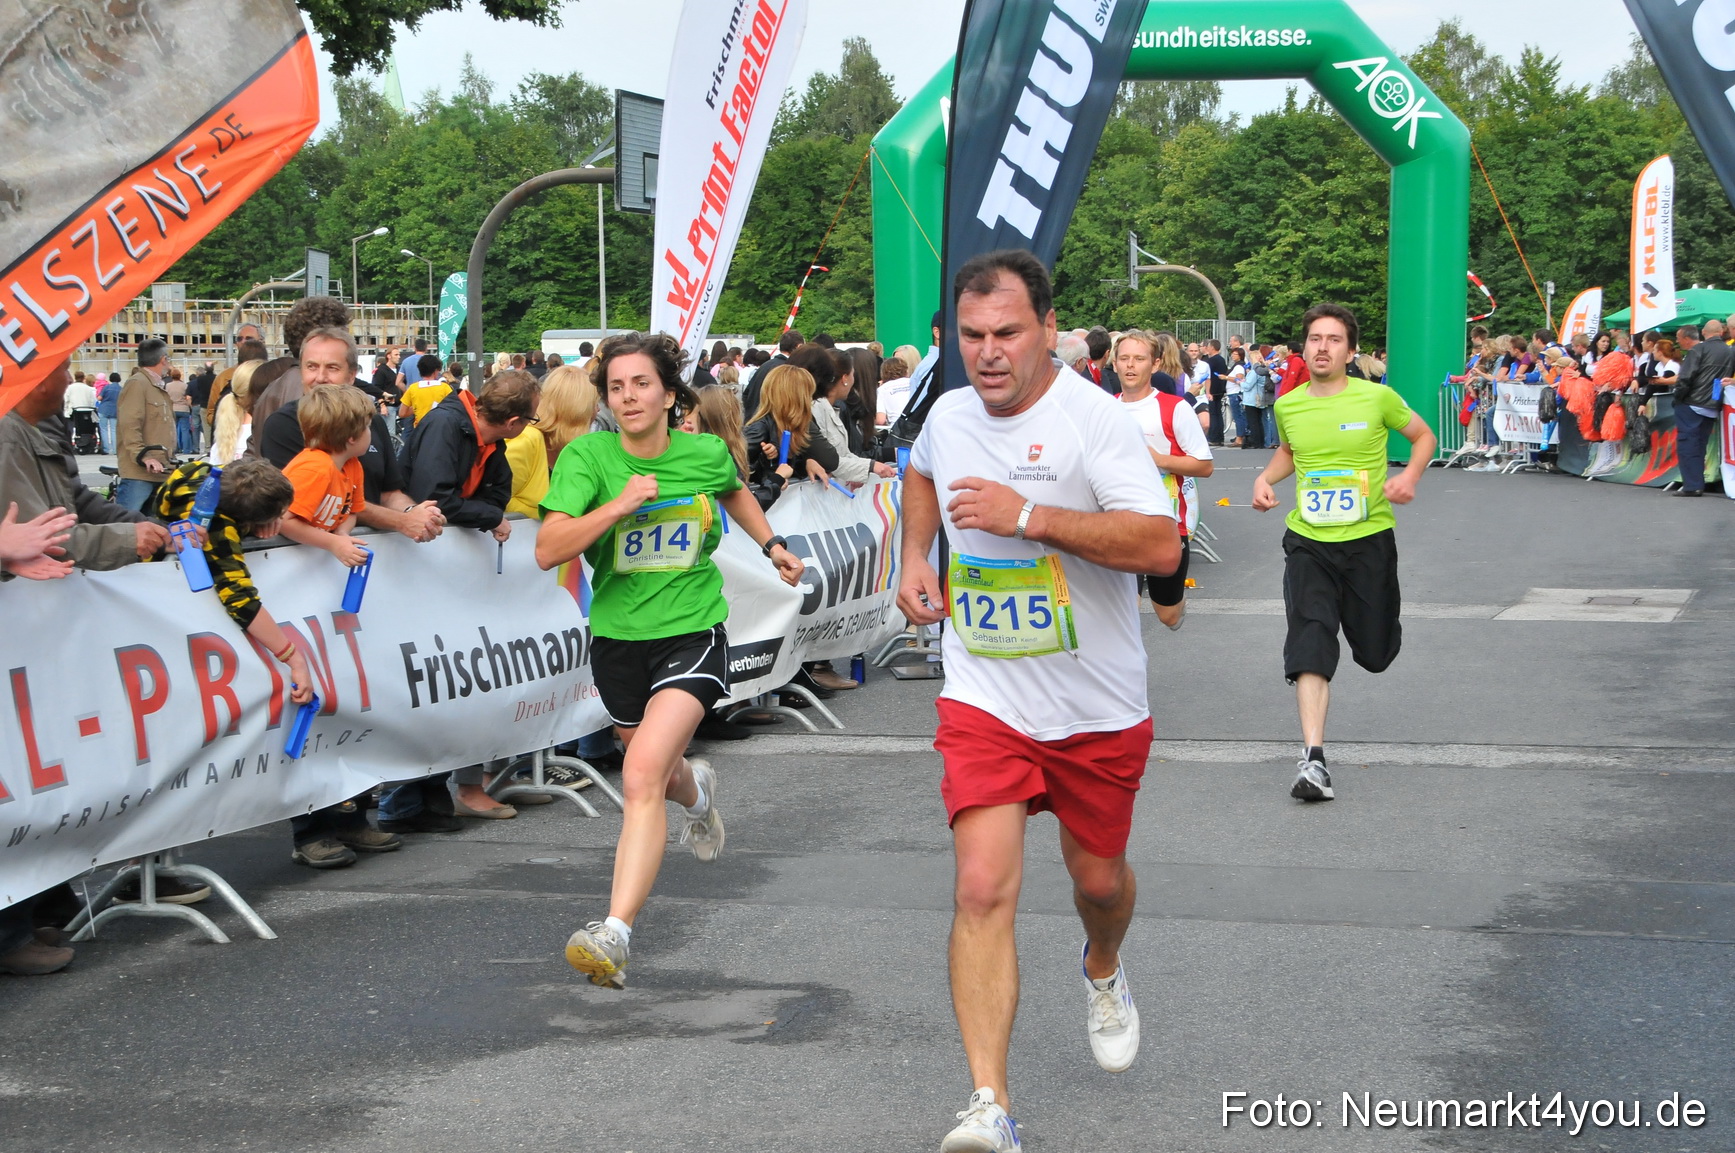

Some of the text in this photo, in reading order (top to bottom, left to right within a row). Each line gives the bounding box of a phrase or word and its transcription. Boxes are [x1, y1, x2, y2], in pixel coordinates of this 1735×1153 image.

[976, 0, 1117, 240] THU
[1332, 57, 1443, 150] AOK
[687, 141, 736, 267] Print
[1660, 185, 1671, 252] www.klebl.de
[0, 112, 253, 370] ELSZENE.DE
[1008, 471, 1058, 482] Lammsbräu
[1306, 489, 1355, 512] 375
[624, 522, 691, 557] 814
[628, 553, 664, 564] Christine
[955, 591, 1053, 631] 1215
[972, 631, 1018, 644] Sebastian
[0, 611, 372, 805] L-PRINT
[513, 691, 557, 722] Druck
